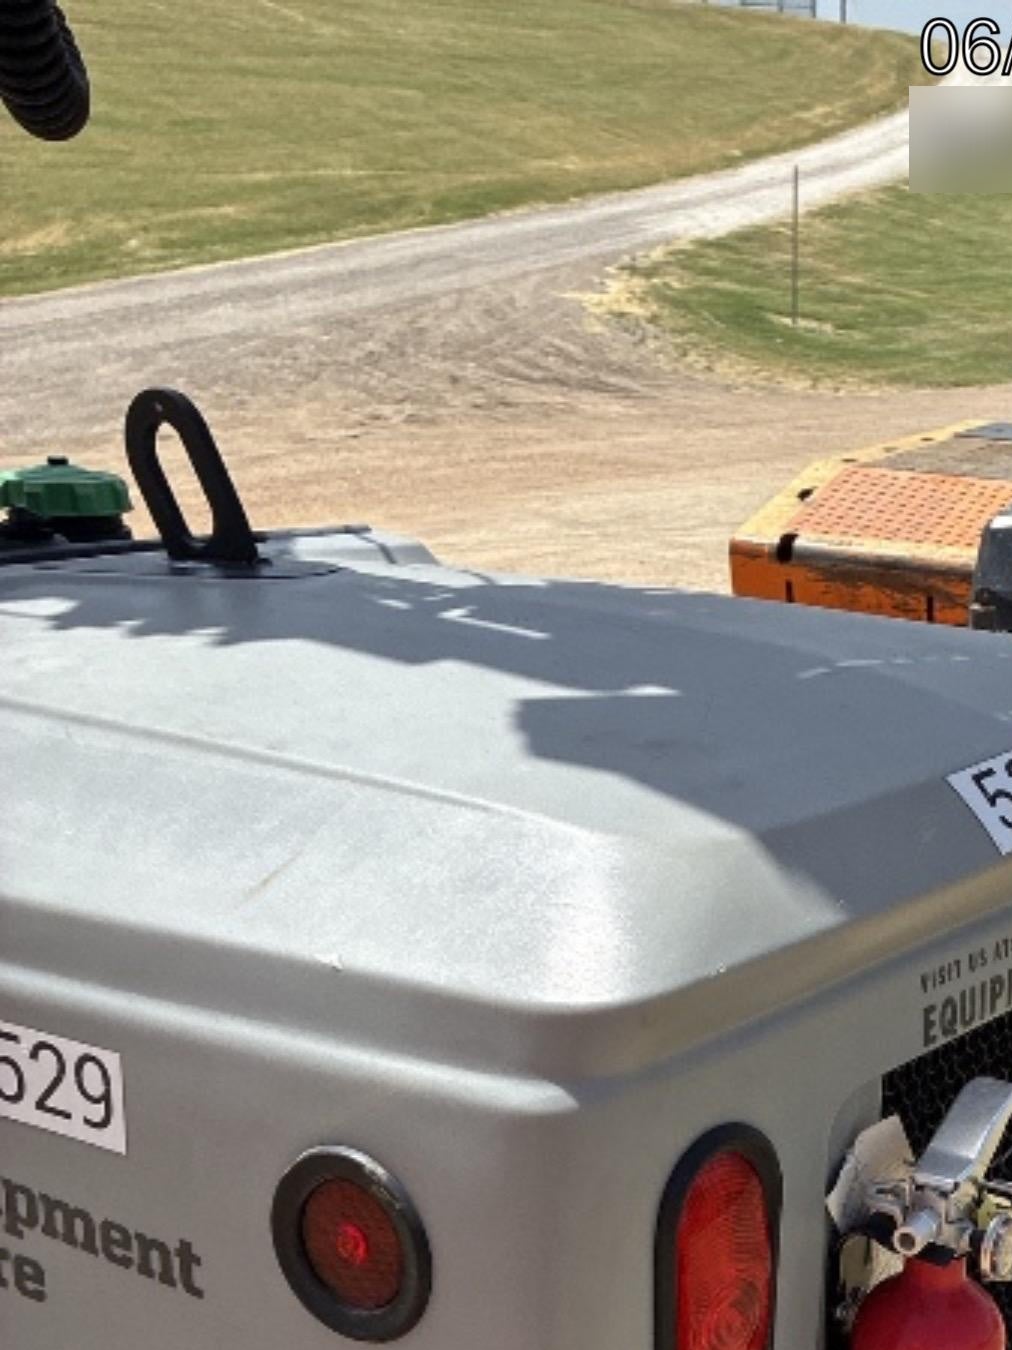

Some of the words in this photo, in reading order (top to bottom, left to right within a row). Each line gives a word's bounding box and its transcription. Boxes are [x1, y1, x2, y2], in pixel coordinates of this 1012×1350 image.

[920, 958, 962, 994] VISIT
[968, 948, 988, 973] US
[0, 1176, 205, 1301] pment
